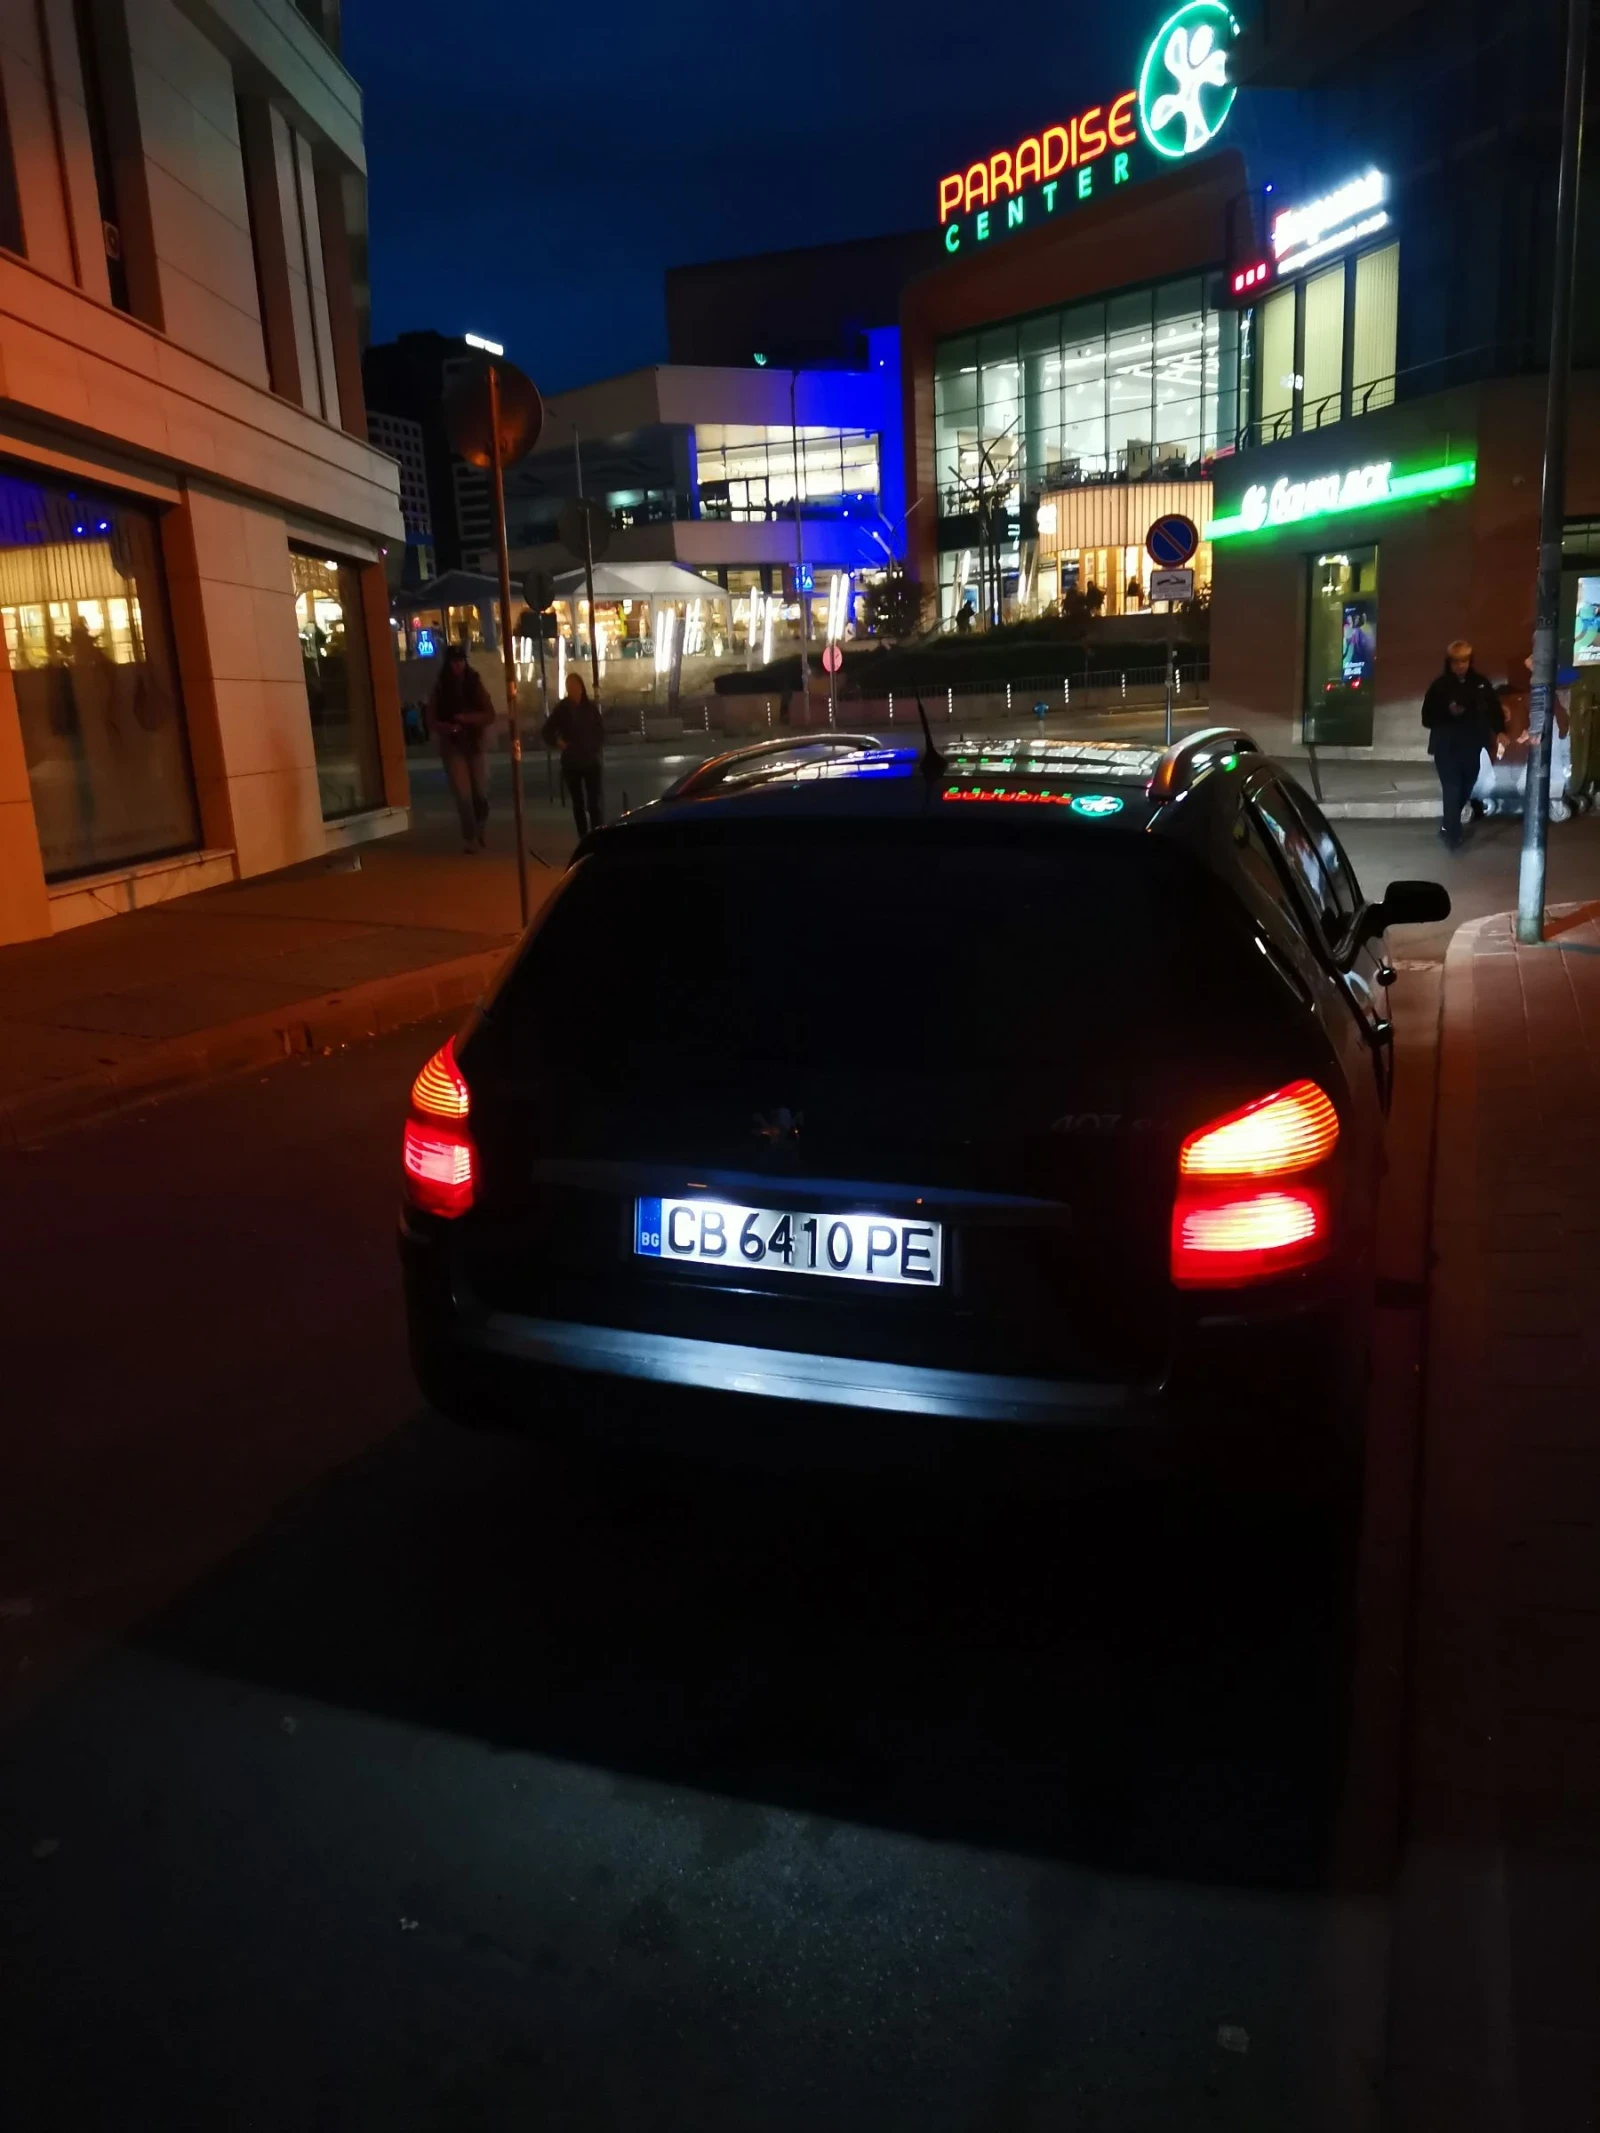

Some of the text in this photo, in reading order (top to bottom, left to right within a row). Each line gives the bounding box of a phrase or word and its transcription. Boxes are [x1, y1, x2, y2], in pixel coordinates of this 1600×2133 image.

[940, 90, 1137, 223] PARADISE
[944, 152, 1130, 254] CENTER
[641, 1231, 660, 1247] BG
[668, 1206, 935, 1282] CB 6410 PE
